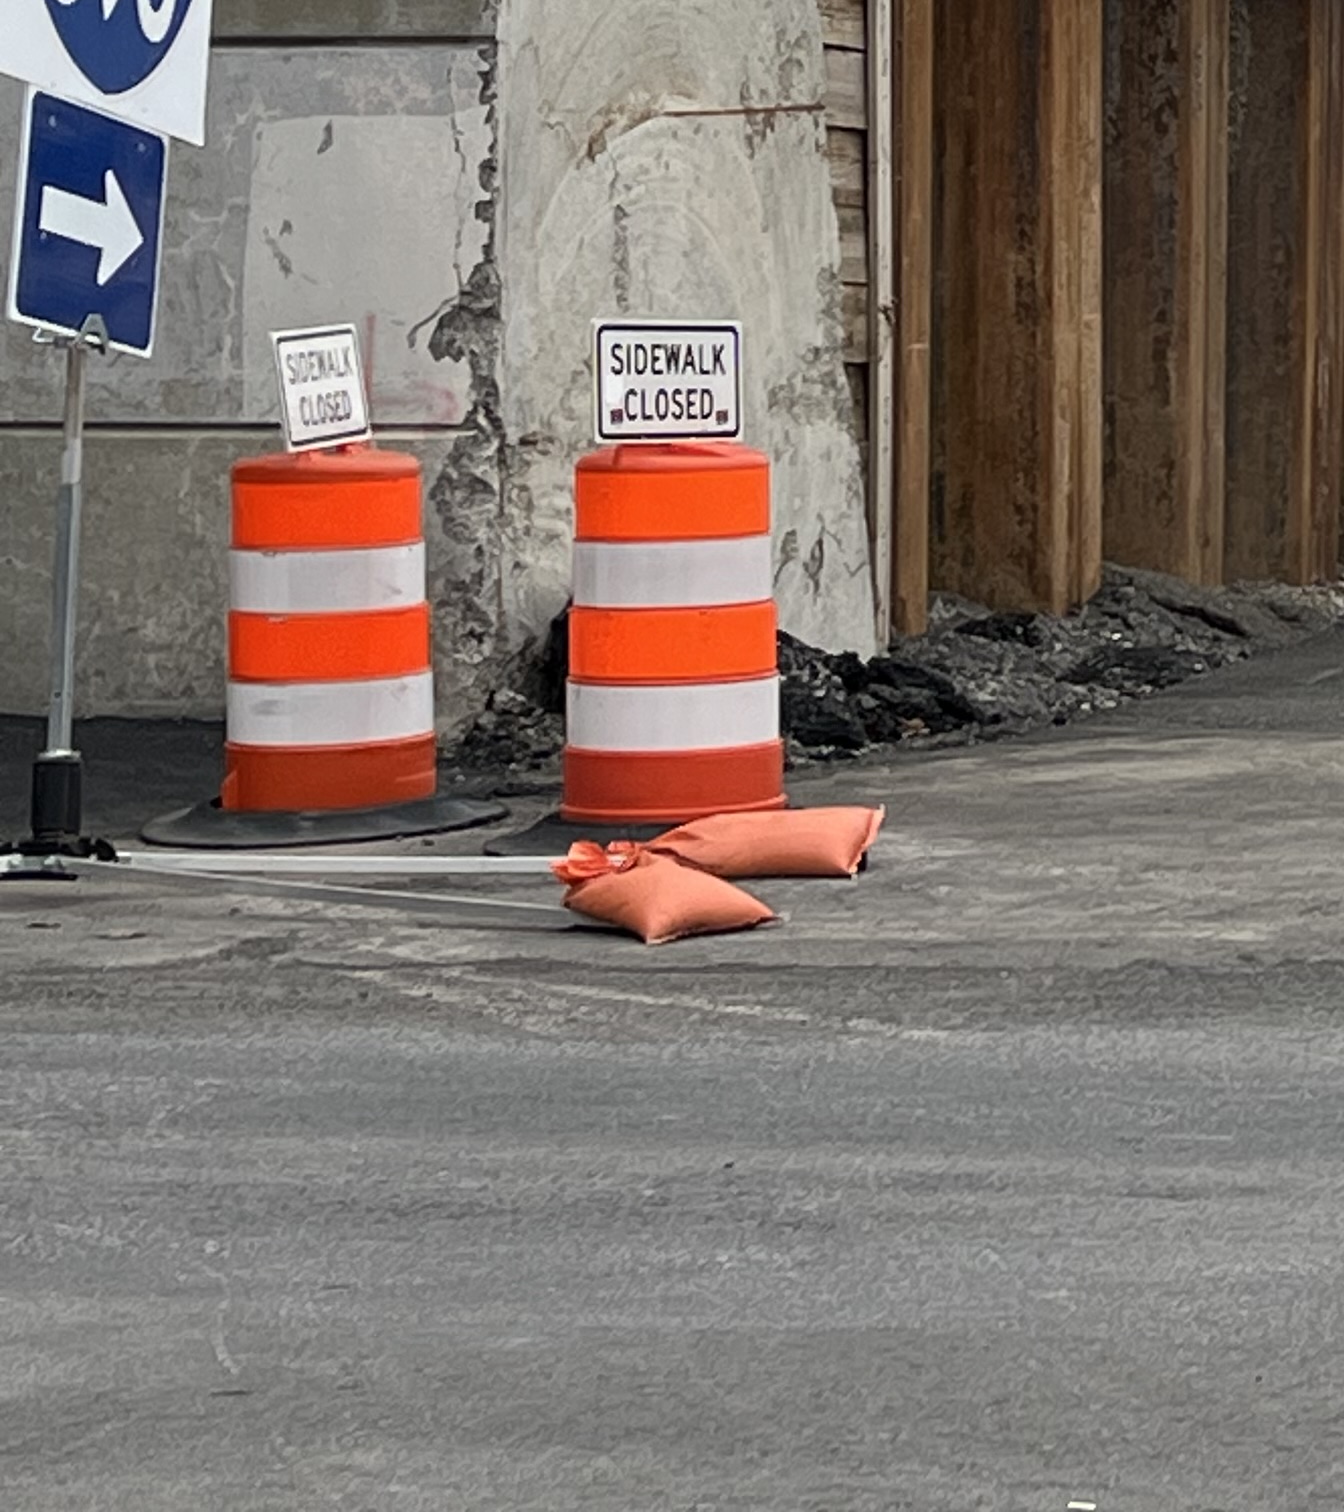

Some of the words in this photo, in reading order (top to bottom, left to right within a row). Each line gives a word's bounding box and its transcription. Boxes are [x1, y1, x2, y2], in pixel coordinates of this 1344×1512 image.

[286, 346, 353, 385] SIDEWALK
[610, 343, 726, 375] SIDEWALK
[299, 390, 352, 426] CLOSED
[624, 388, 714, 421] CLOSED
